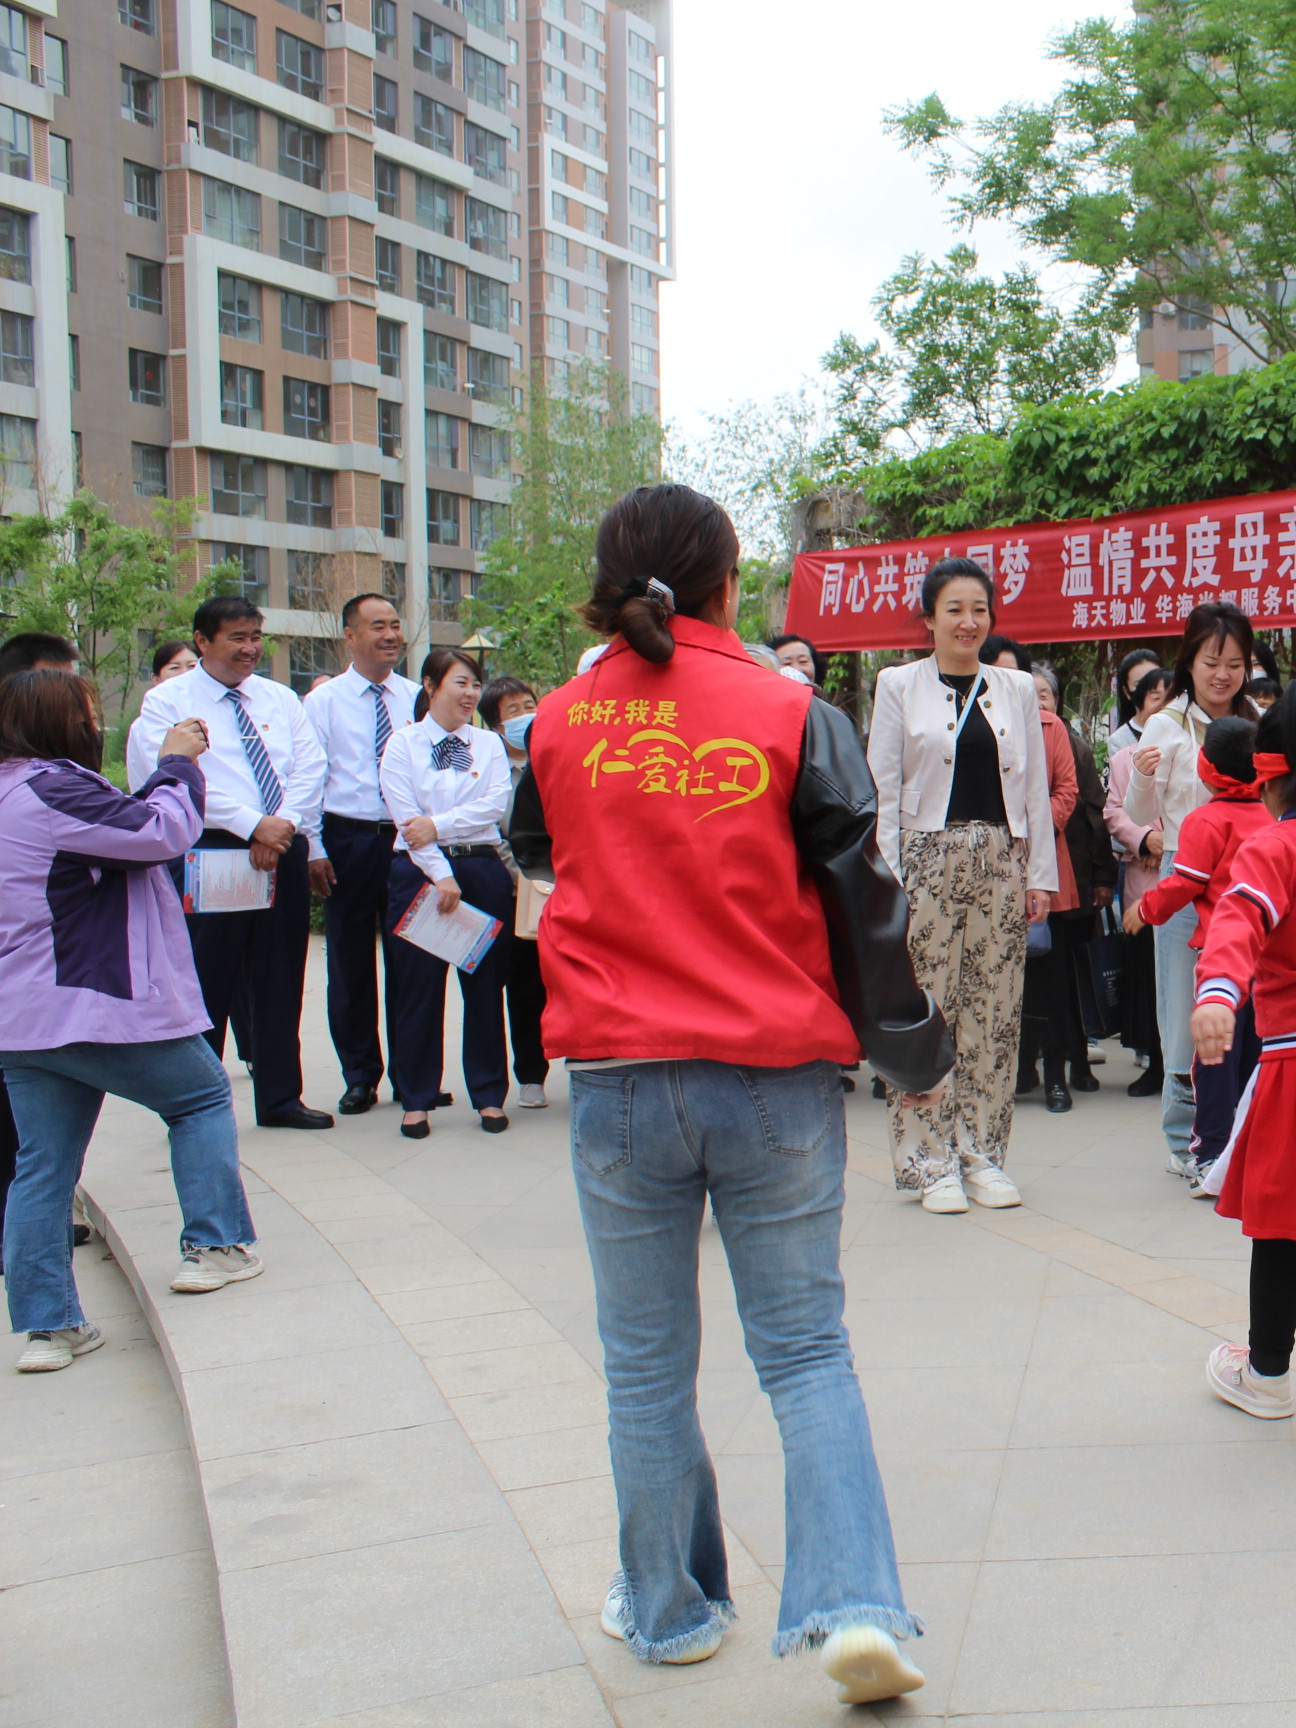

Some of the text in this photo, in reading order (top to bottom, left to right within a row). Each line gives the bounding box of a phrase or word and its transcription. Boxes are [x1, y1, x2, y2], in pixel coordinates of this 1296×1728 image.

[818, 538, 1031, 616] 同心共筑梦
[1072, 597, 1146, 629] 海天物业
[582, 737, 754, 797] 仁爱社工
